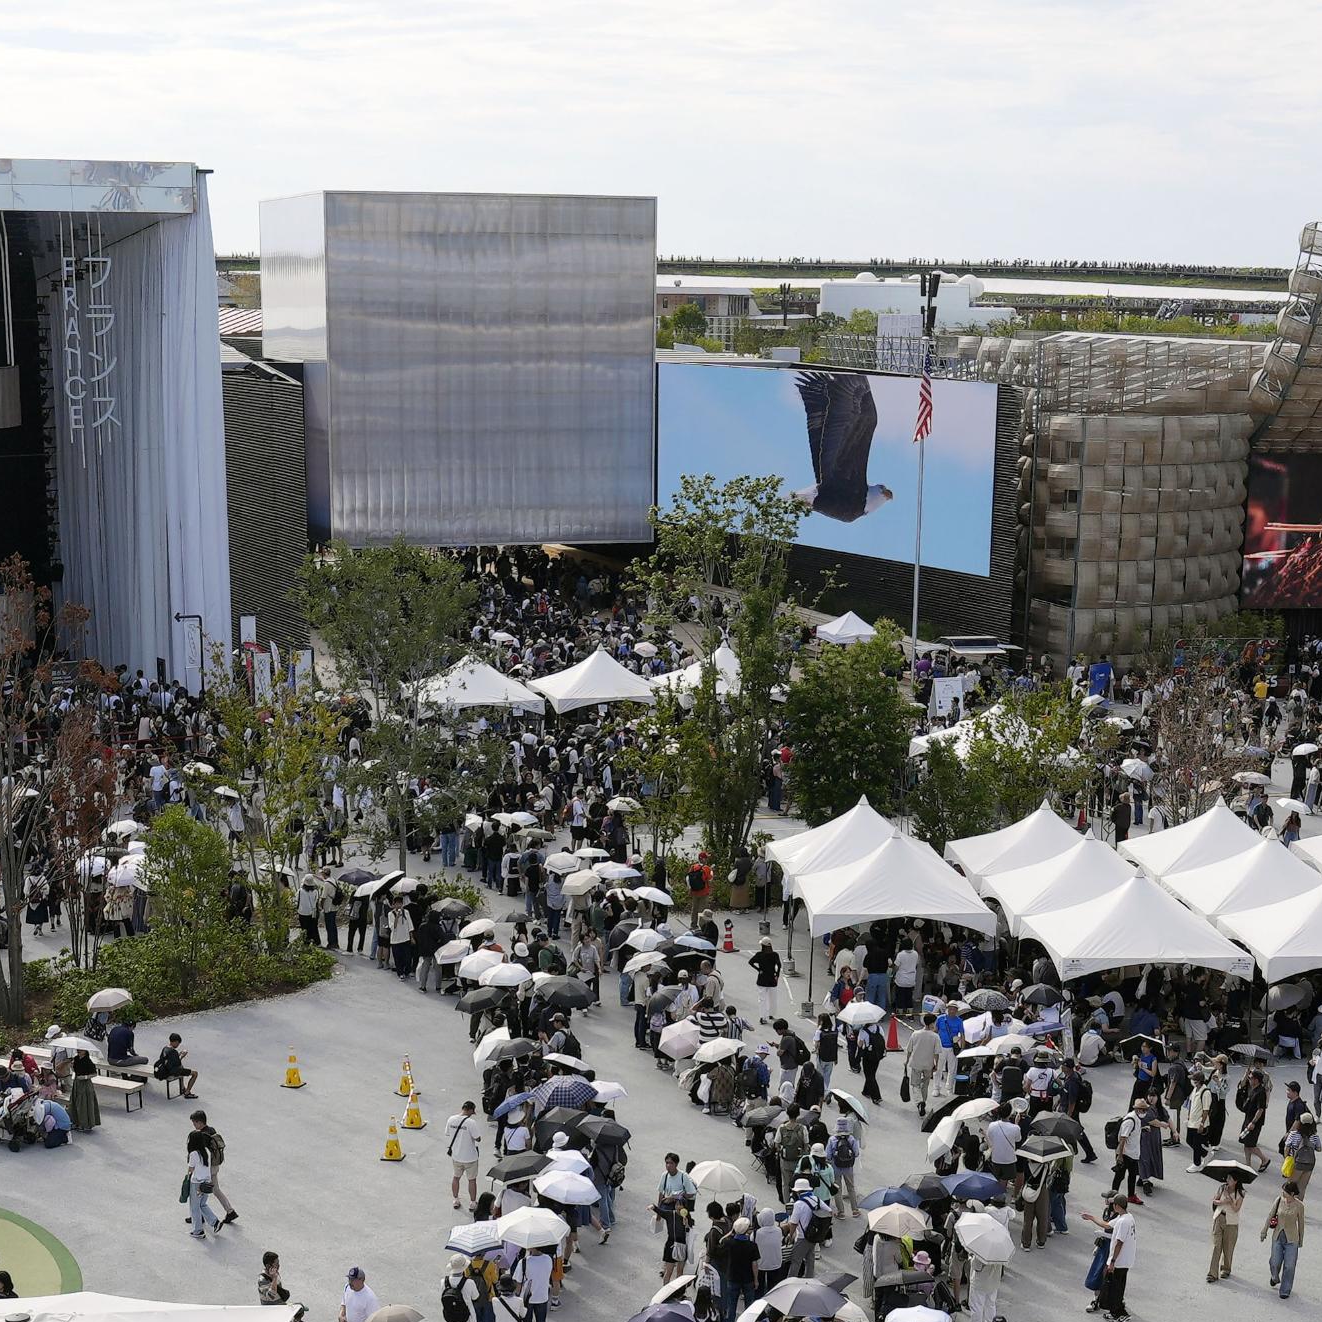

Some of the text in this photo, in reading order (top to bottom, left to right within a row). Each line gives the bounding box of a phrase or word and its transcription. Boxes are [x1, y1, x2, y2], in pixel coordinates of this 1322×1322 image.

[63, 257, 87, 429] FRANCE
[82, 257, 122, 428] フランス
